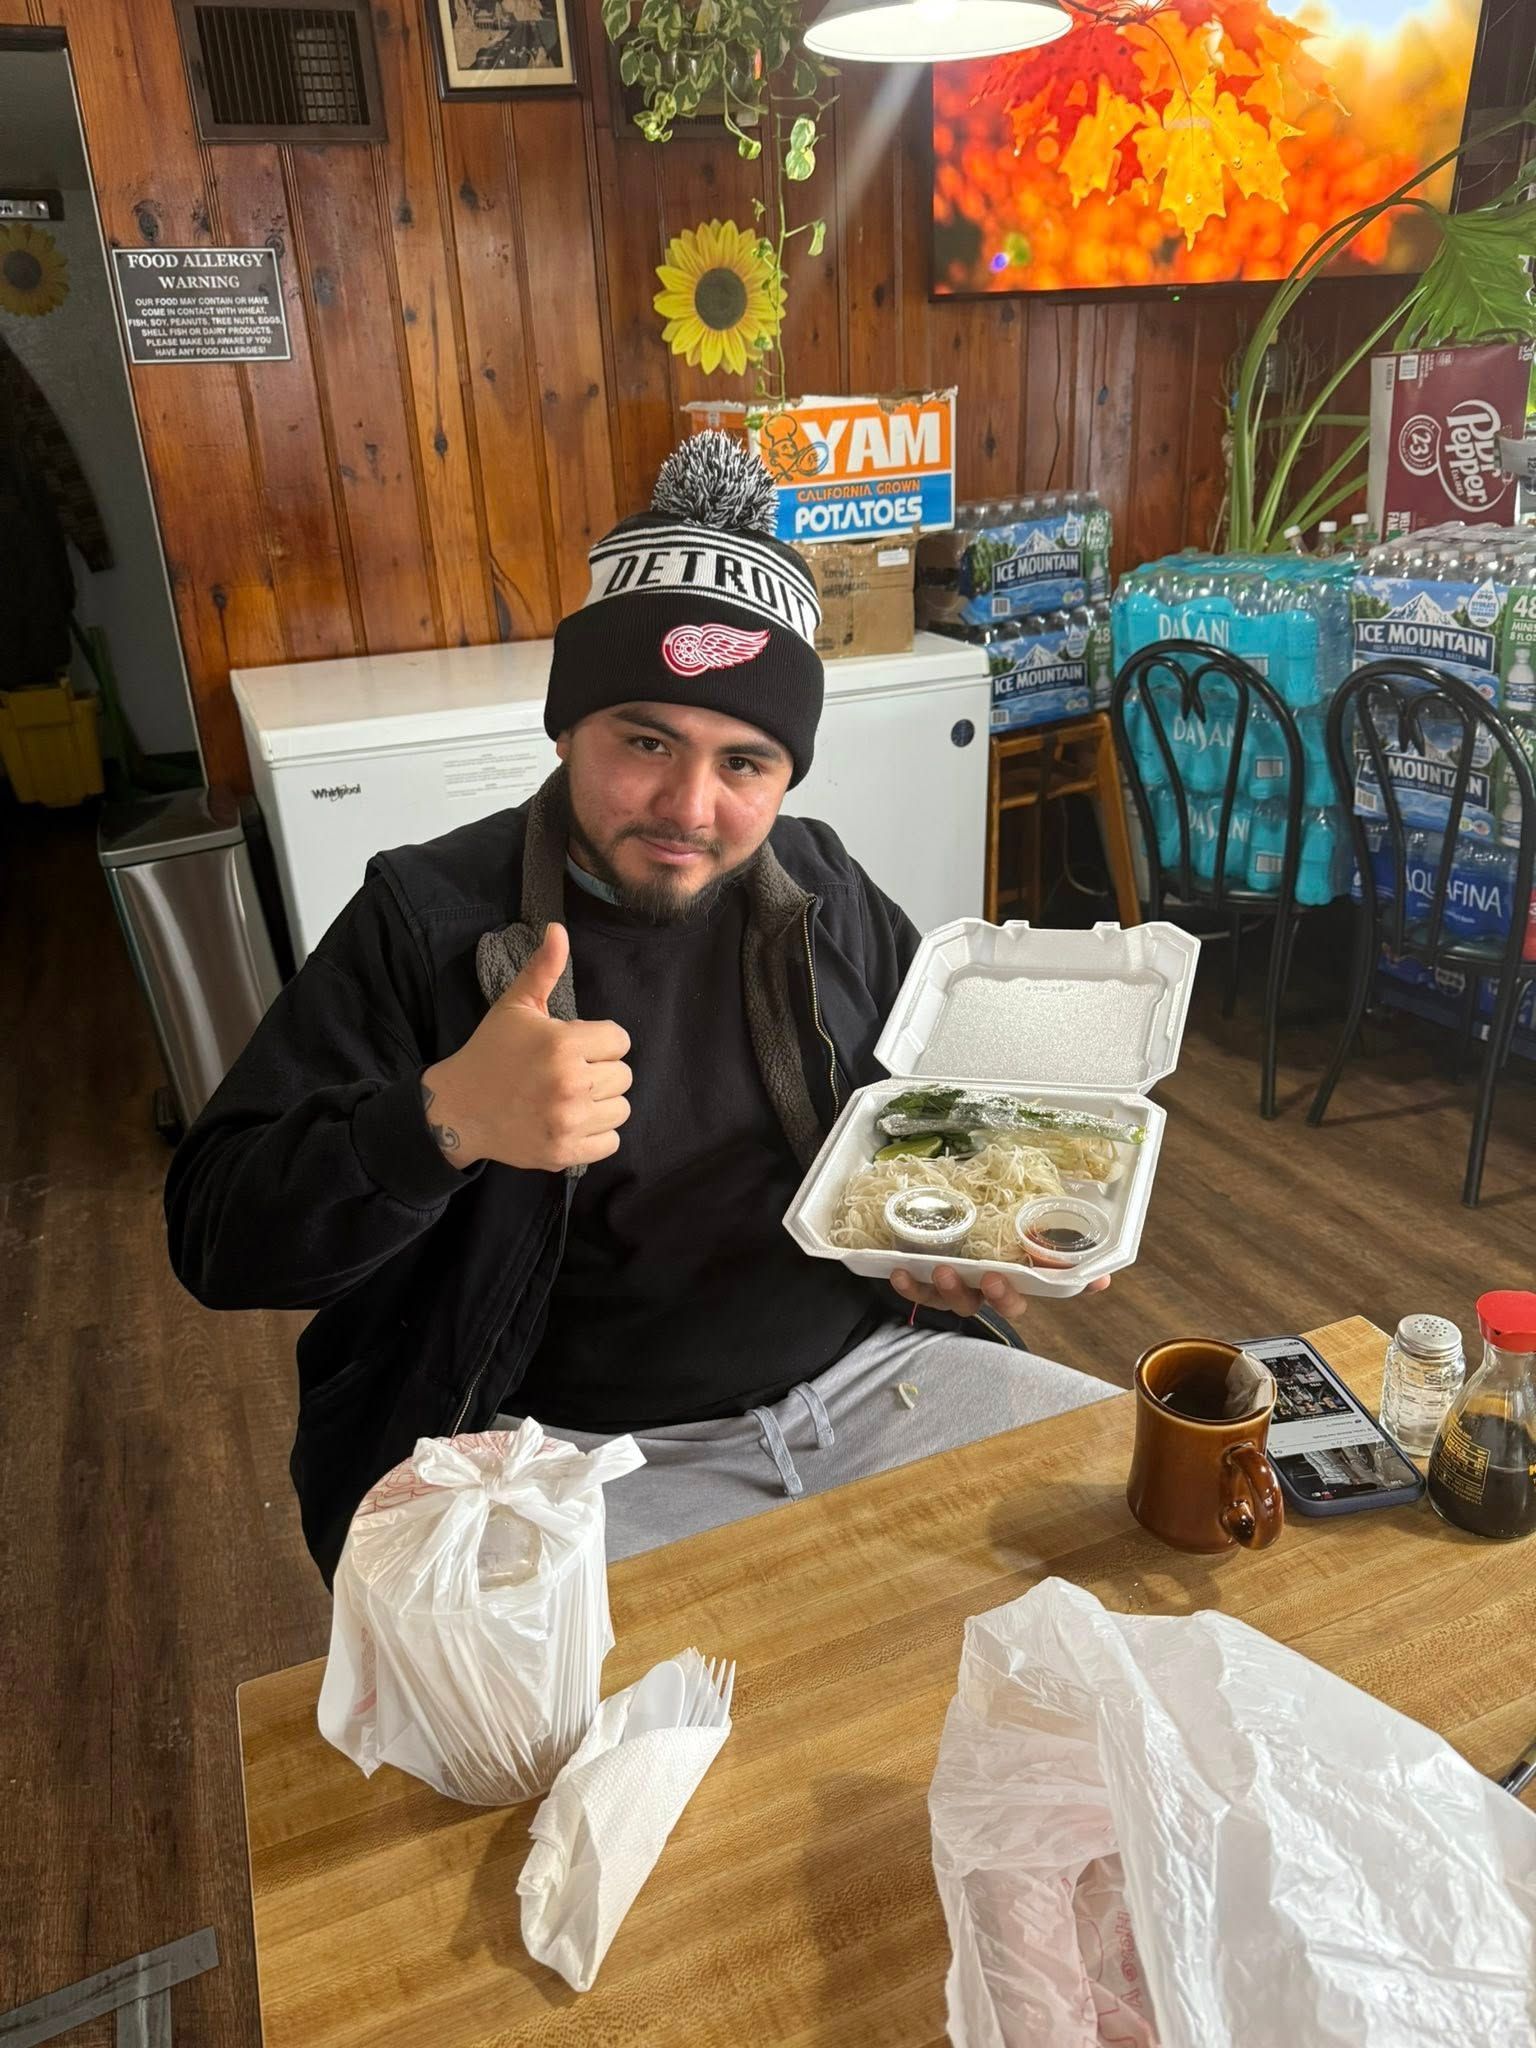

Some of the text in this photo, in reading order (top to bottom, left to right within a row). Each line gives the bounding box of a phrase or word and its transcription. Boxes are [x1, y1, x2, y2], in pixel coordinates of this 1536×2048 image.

[127, 253, 264, 268] FOOD ALLERGY
[158, 275, 240, 289] WARNING
[135, 296, 269, 306] OUR FOOD MAY CONTAIN OR HAVE
[141, 308, 166, 317] COME
[167, 308, 176, 316] IN
[177, 307, 215, 316] CONTACT
[216, 307, 237, 315] WITH
[142, 329, 168, 337] SHELL
[169, 328, 188, 336] FISH
[202, 327, 227, 335] DAIRY
[212, 317, 232, 325] TREE
[146, 336, 272, 347] PLEASE MAKE US AWARE IF YOU
[155, 348, 177, 357] HAVE
[178, 347, 195, 356] ANY
[196, 347, 220, 355] FOOD
[800, 411, 941, 475] YAM
[1409, 432, 1432, 457] 23
[1444, 400, 1502, 504] Pepper
[797, 479, 921, 502] CALIFORNIA GROWN
[795, 495, 923, 534] POTATOES
[996, 563, 1016, 584] ICE
[1017, 551, 1080, 579] MOUNTAIN
[603, 551, 808, 640] DETROIT
[1093, 627, 1111, 645] 48
[1159, 610, 1229, 648] DASANI
[1358, 622, 1488, 659] ICE MOUNTAIN
[995, 674, 1014, 696] ICE
[1016, 664, 1083, 691] MOUNTAIN
[1387, 755, 1481, 798] MOUNTN
[311, 783, 361, 802] Whirlpool
